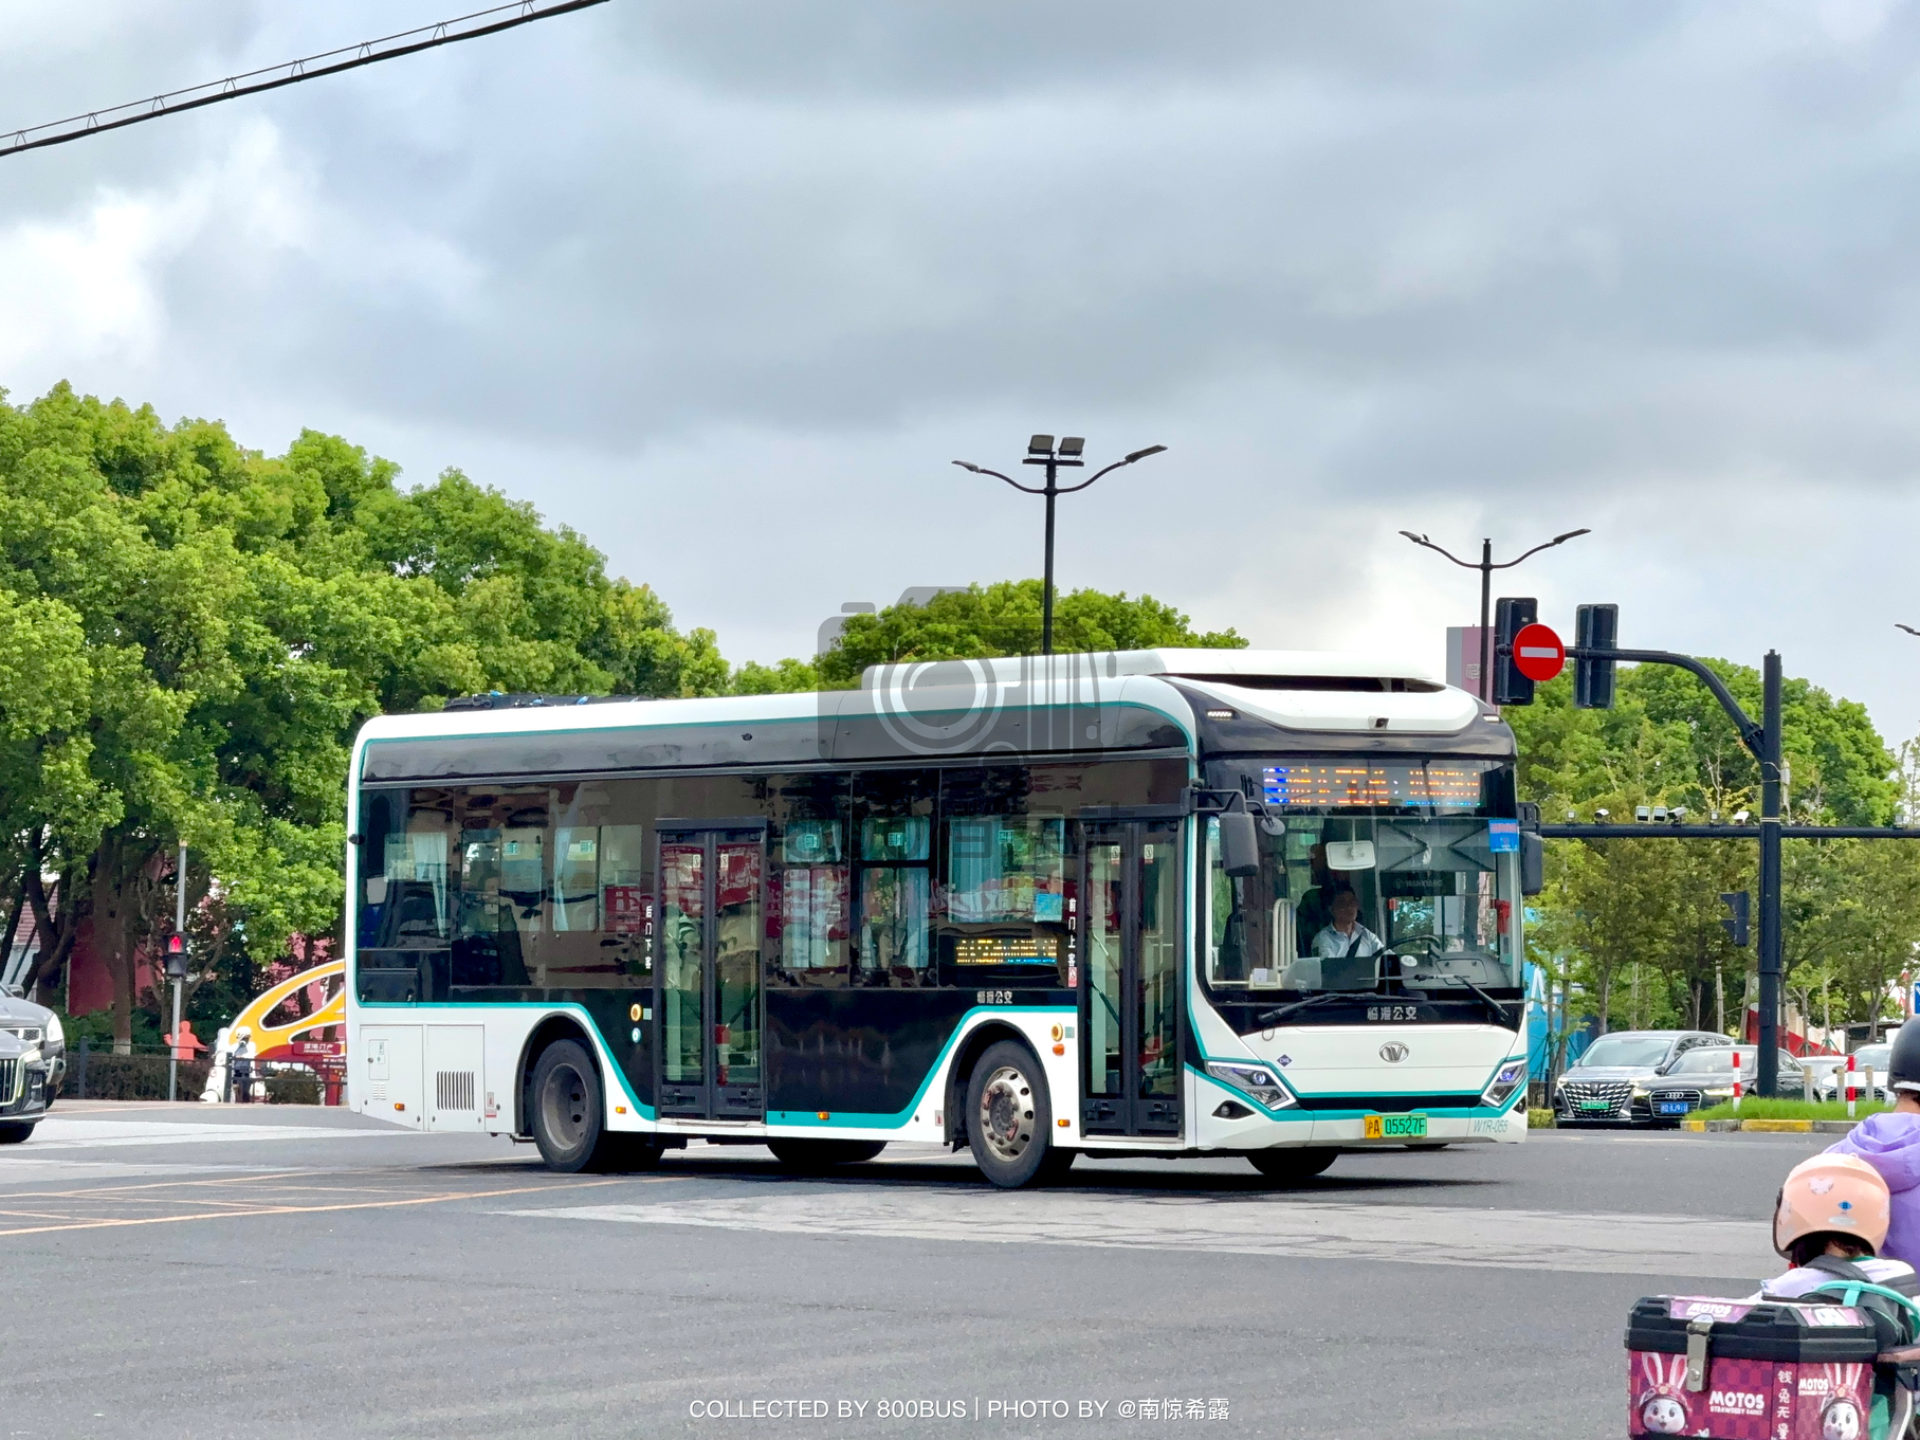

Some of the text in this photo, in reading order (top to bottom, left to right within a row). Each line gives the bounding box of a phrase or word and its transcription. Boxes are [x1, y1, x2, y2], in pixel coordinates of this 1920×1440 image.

[1367, 1005, 1418, 1021] 临港公交
[1687, 1302, 1732, 1315] MOTOS
[1798, 1377, 1829, 1391] MOTOS
[1709, 1390, 1765, 1410] MOTOS
